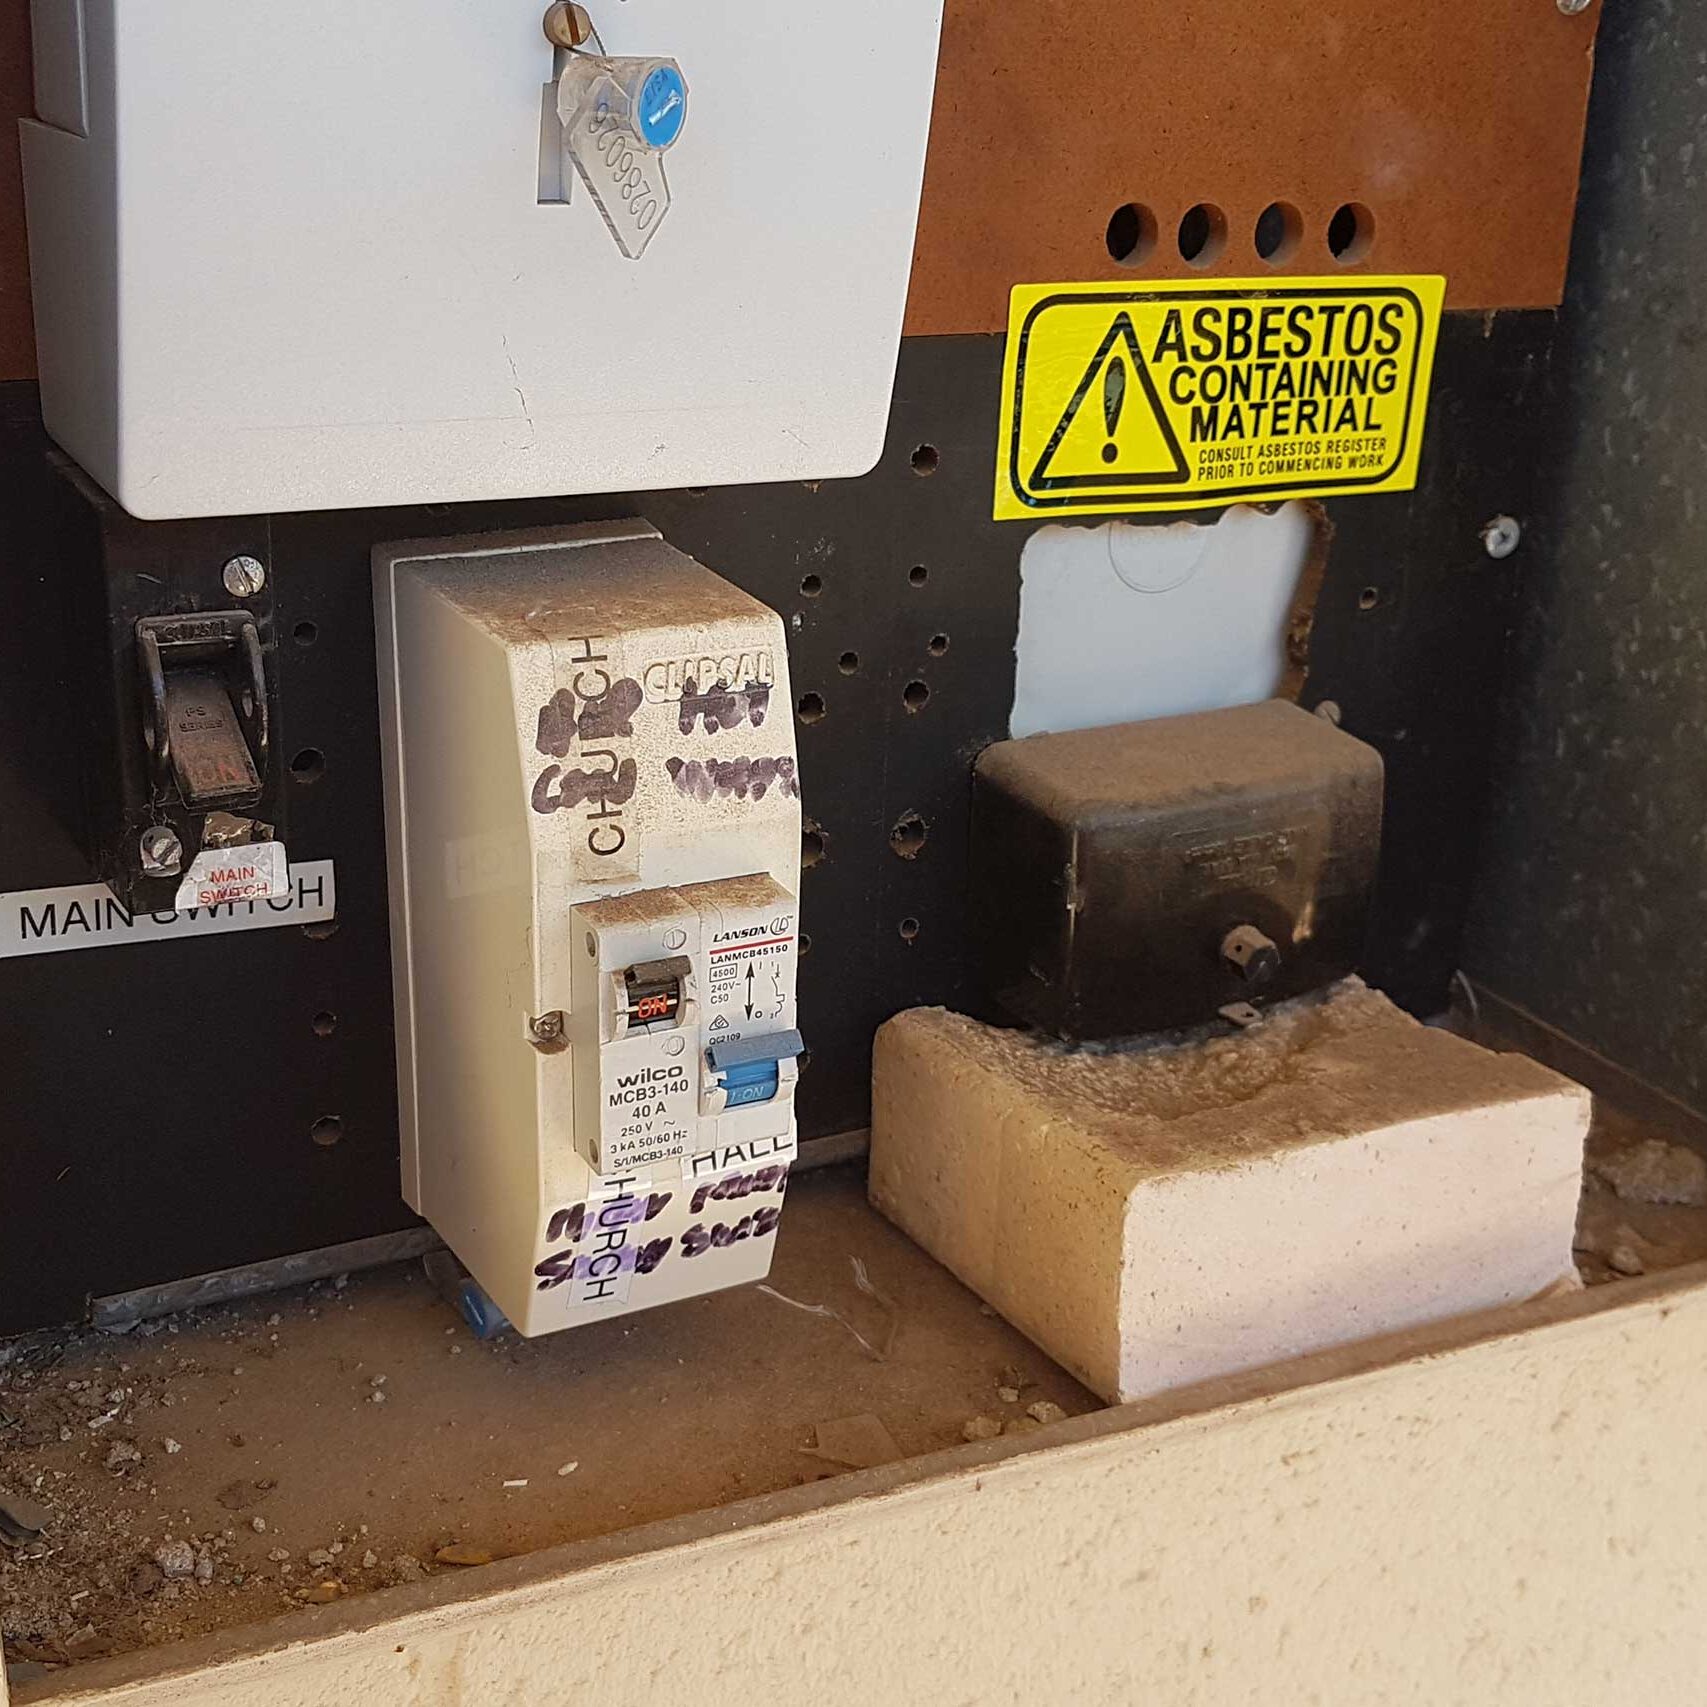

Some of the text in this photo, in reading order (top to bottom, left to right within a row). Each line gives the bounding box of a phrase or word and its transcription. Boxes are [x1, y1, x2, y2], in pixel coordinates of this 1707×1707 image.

[1152, 303, 1402, 362] ASBESTOS
[1169, 358, 1397, 405] CONTAINING
[1189, 397, 1383, 443] MATERIAL
[1199, 437, 1386, 464] CONSULT ASBESTOS REGISTER
[1198, 453, 1385, 481] PRIOR TO COMMENCING WORK
[644, 652, 774, 697] CLIPSAL
[209, 866, 256, 883] MAIN
[200, 882, 268, 905] SWITCH
[20, 898, 134, 939] MAIN
[713, 925, 768, 942] LANSON
[710, 944, 788, 965] LANMCB45150
[712, 967, 735, 978] 4500
[638, 993, 668, 1018] ON
[710, 993, 729, 1005] C50
[617, 1066, 683, 1088] wilco
[609, 1079, 688, 1107] MCB3-140
[632, 1101, 667, 1119] 40 A
[621, 1124, 643, 1137] 250
[645, 1121, 653, 1131] V
[610, 1130, 688, 1154] 3 kA 50/60 Hz
[583, 1169, 636, 1301] HURCH
